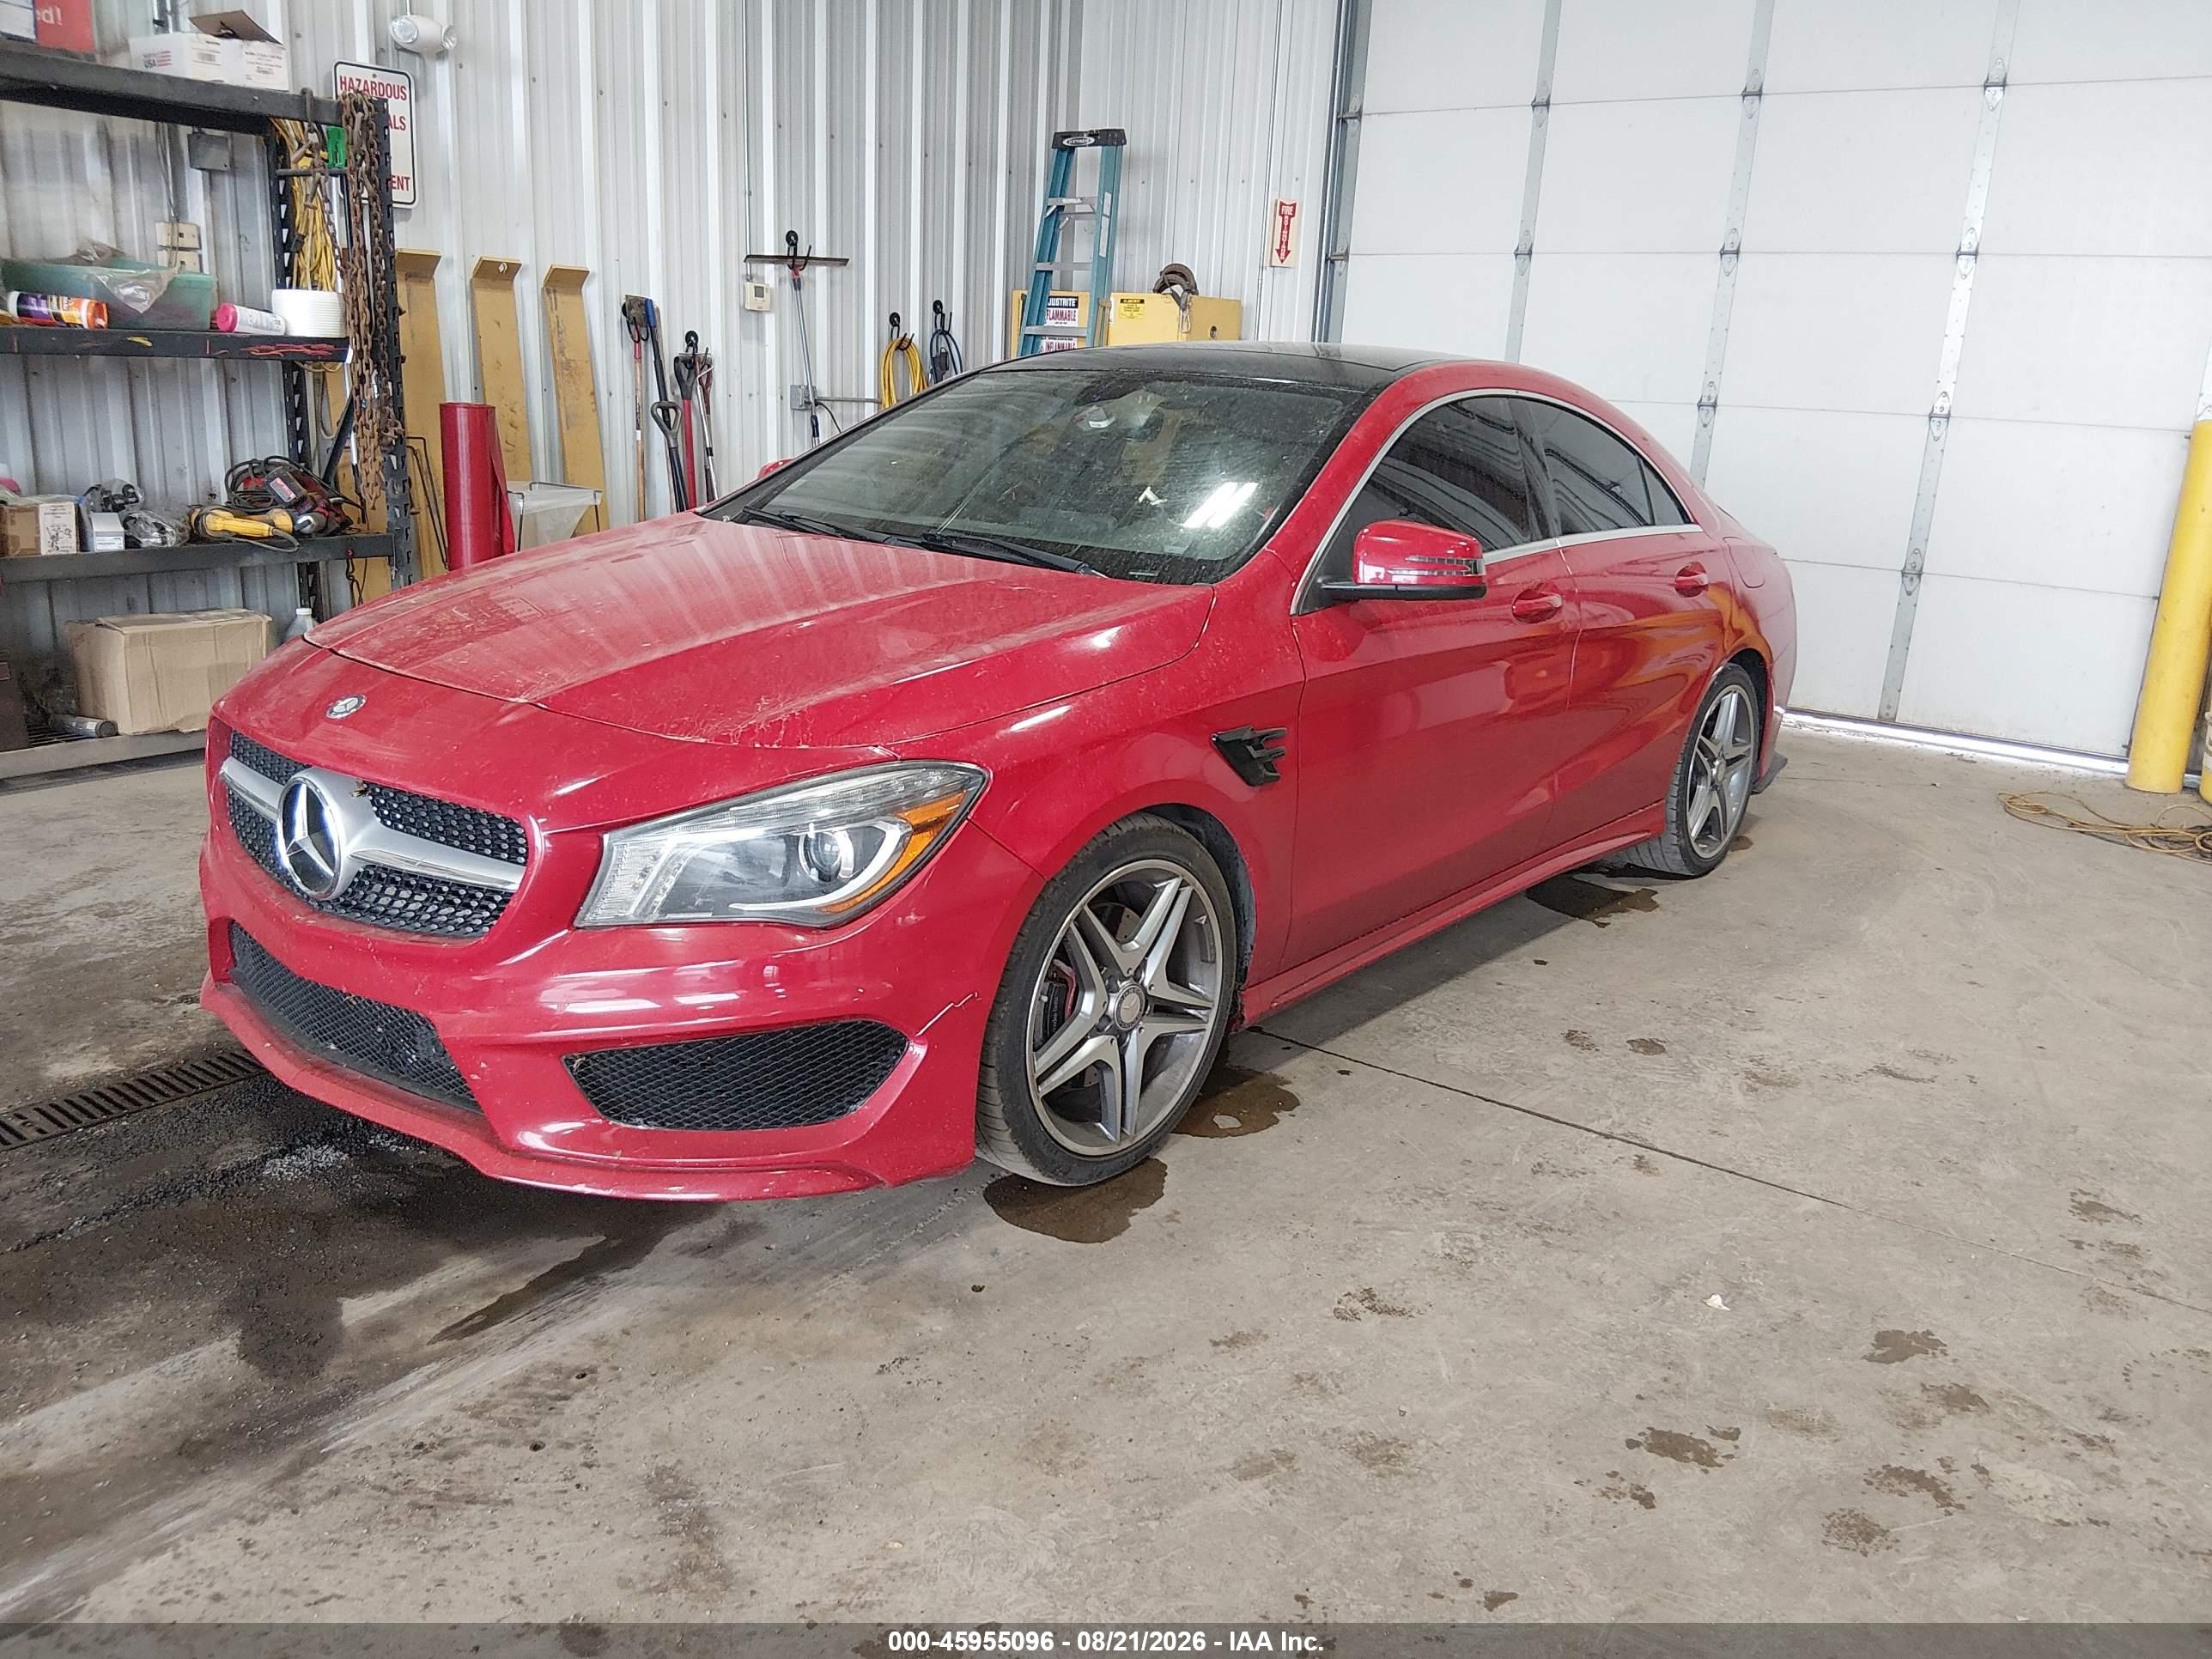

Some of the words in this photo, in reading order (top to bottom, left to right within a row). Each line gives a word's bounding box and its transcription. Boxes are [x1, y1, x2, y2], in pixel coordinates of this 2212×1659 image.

[339, 75, 408, 101] HAZARDOUS
[1281, 205, 1294, 216] FIRE
[1048, 297, 1077, 307] JUSTRITE
[1046, 309, 1077, 322] FLAMMABLE
